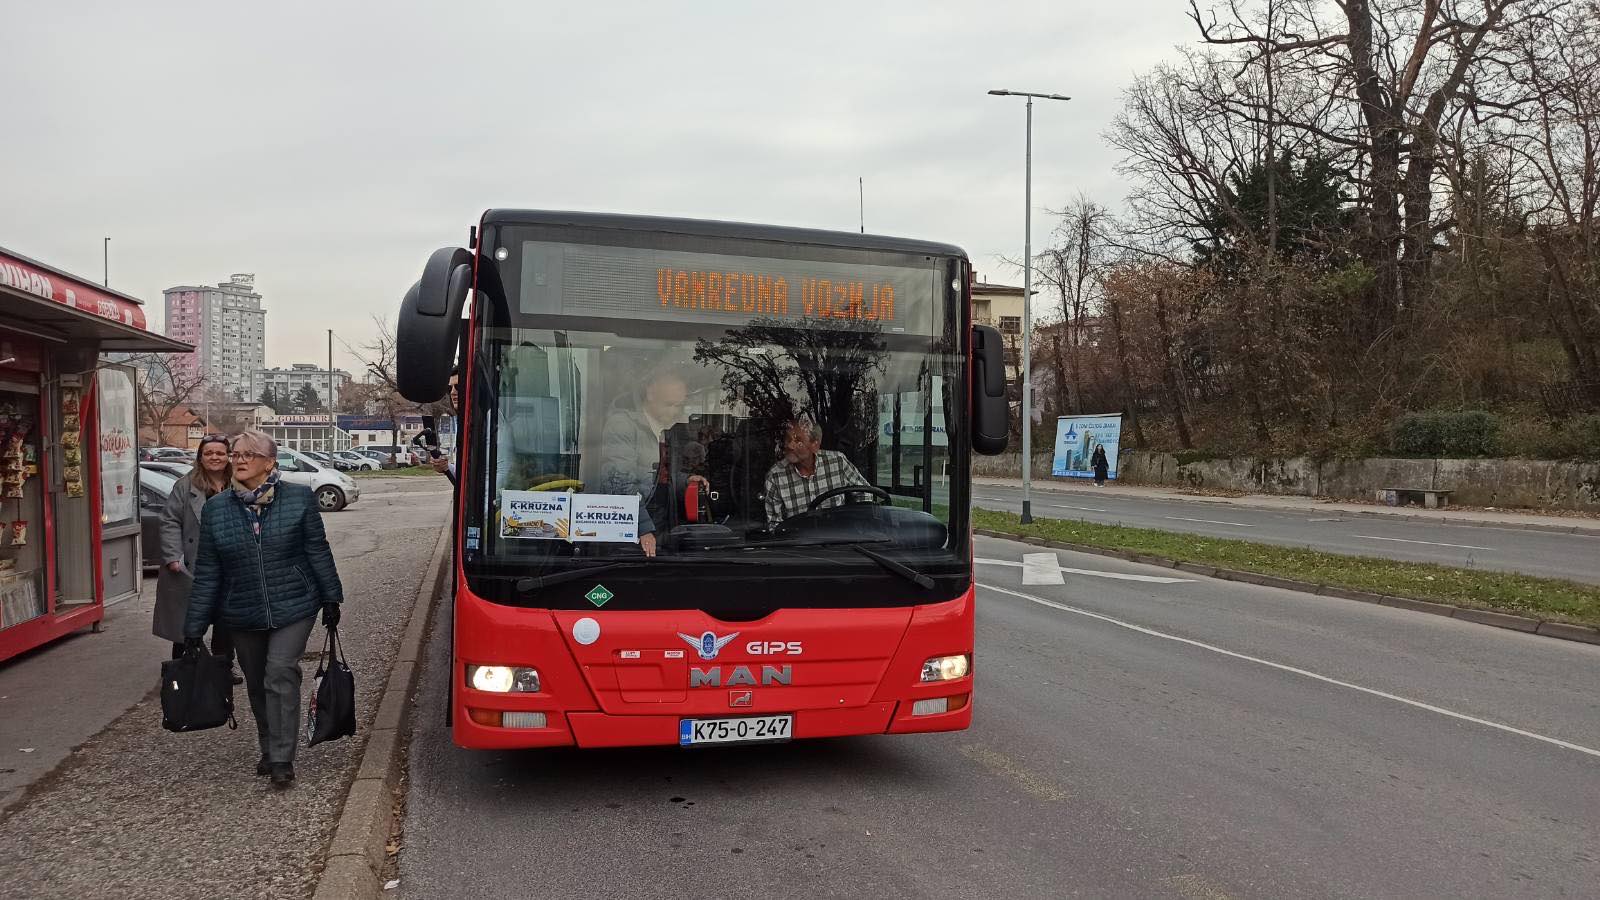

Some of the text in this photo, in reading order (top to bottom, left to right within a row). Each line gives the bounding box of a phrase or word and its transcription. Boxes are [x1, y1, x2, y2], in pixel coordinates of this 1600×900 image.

[657, 267, 790, 316] VANREDNA
[576, 511, 633, 521] K-KRUŽNA
[591, 592, 607, 600] CNG
[746, 641, 803, 655] GIPS
[690, 664, 792, 687] MAN
